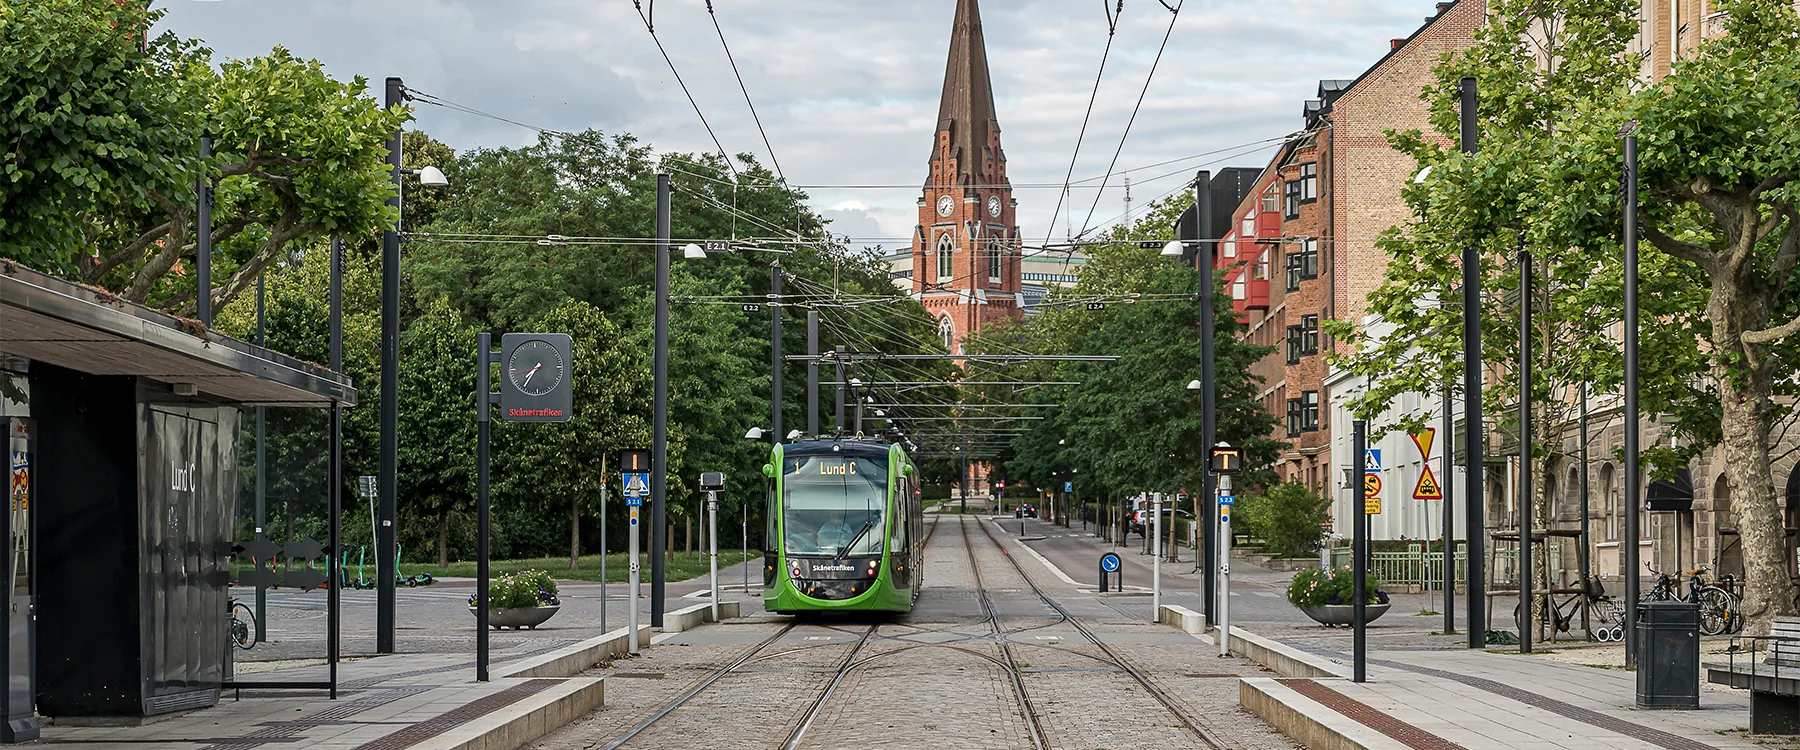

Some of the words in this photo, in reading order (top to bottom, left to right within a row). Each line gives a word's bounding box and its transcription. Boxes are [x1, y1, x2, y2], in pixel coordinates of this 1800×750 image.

[707, 242, 712, 250] E
[713, 242, 726, 250] 2.1
[508, 407, 563, 417] Skånetrafiken
[794, 461, 800, 475] 1
[820, 461, 846, 475] Lund
[849, 461, 856, 475] C
[171, 460, 188, 492] Lund
[189, 462, 196, 493] C
[812, 564, 855, 572] Skånetrafiken
